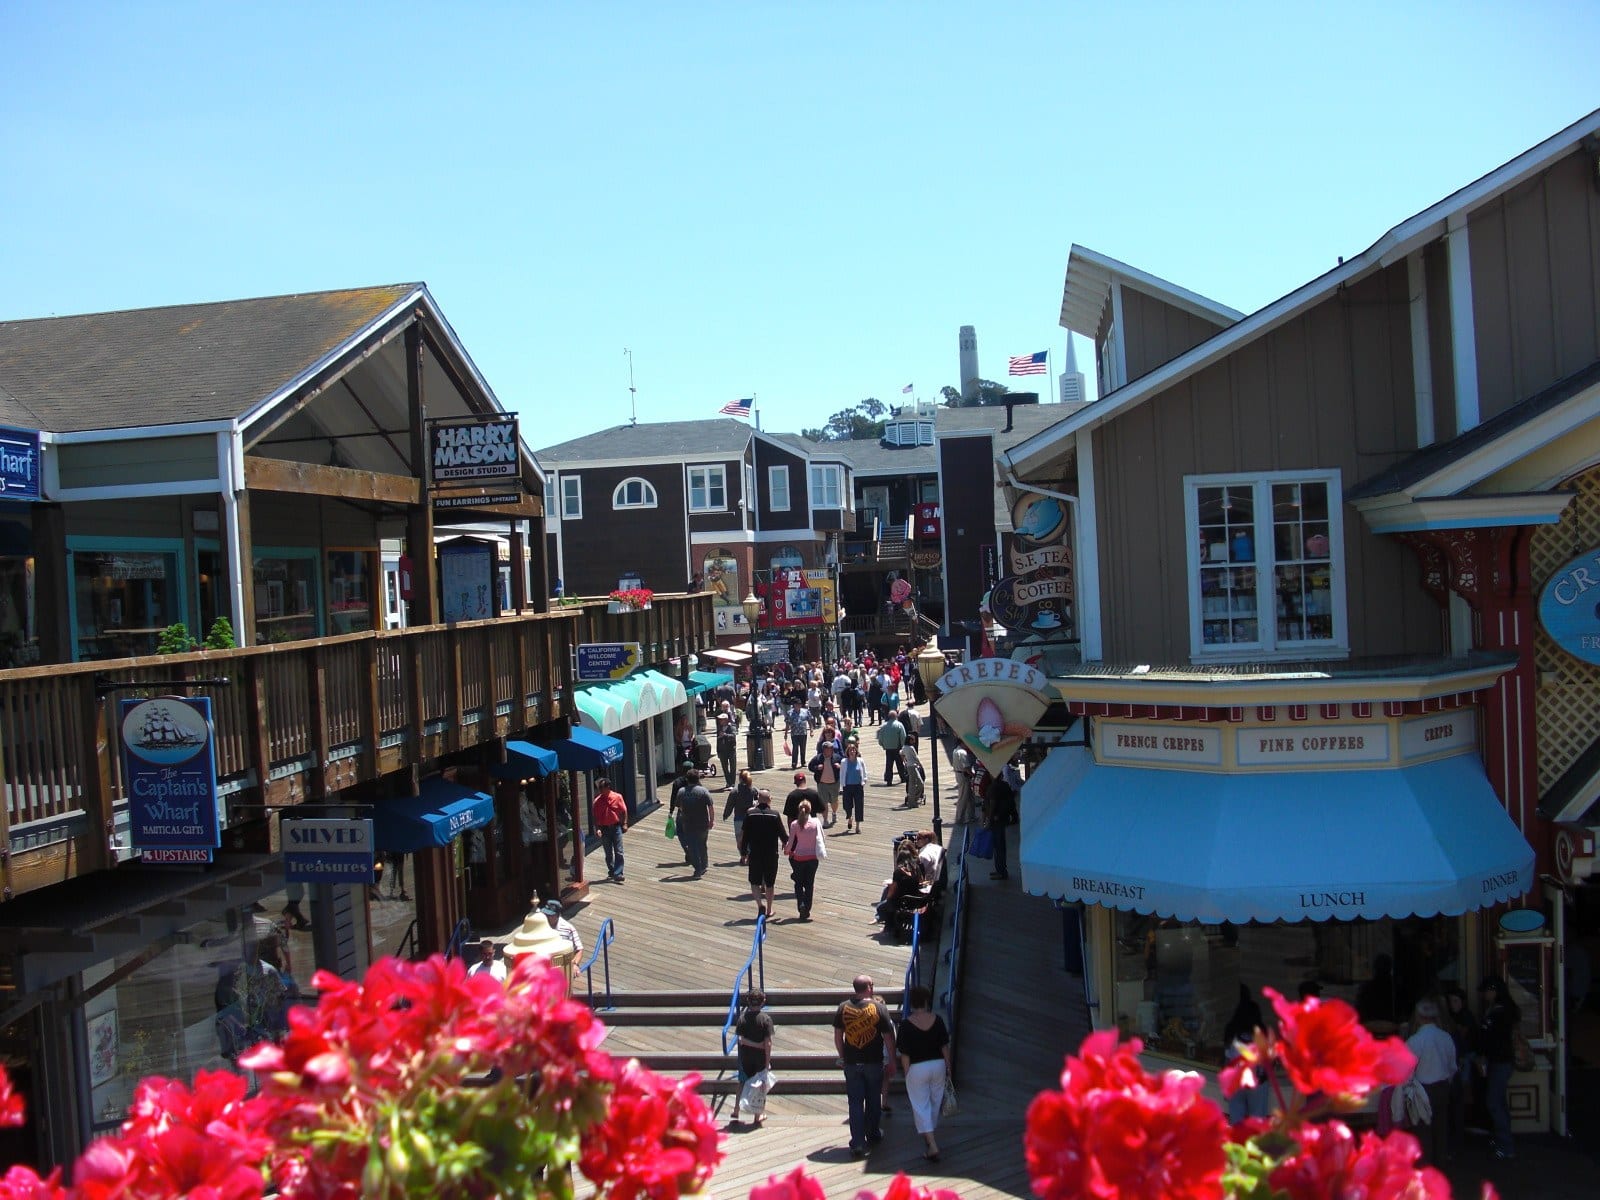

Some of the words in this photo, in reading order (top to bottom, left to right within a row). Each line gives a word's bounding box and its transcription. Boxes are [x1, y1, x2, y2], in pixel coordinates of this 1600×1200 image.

[438, 423, 513, 447] HARRY
[434, 443, 516, 467] MASON
[444, 468, 474, 476] DESIGN
[477, 466, 508, 474] STUDIO
[452, 497, 490, 505] EARRINGS
[1016, 554, 1038, 570] S.F.
[1041, 552, 1071, 564] TEA
[1017, 581, 1072, 600] COFFEE
[1555, 558, 1600, 605] CR
[945, 661, 1036, 688] CREPES
[1424, 724, 1454, 742] CREPES
[1117, 734, 1158, 749] FRENCH
[1163, 737, 1205, 752] CREPES
[1259, 738, 1295, 752] FINE
[1302, 736, 1365, 751] COFFEES
[159, 768, 178, 781] The
[133, 778, 208, 800] Captain's
[144, 801, 199, 825] Wharf
[142, 825, 182, 835] NAUTICAL
[182, 825, 204, 835] GIFTS
[290, 827, 364, 844] SILVER
[154, 850, 207, 861] UPSTAIRS
[288, 860, 368, 873] Treasures
[1072, 876, 1146, 900] BREAKFAST
[1482, 870, 1519, 893] DINNER
[1299, 892, 1366, 908] LUNCH
